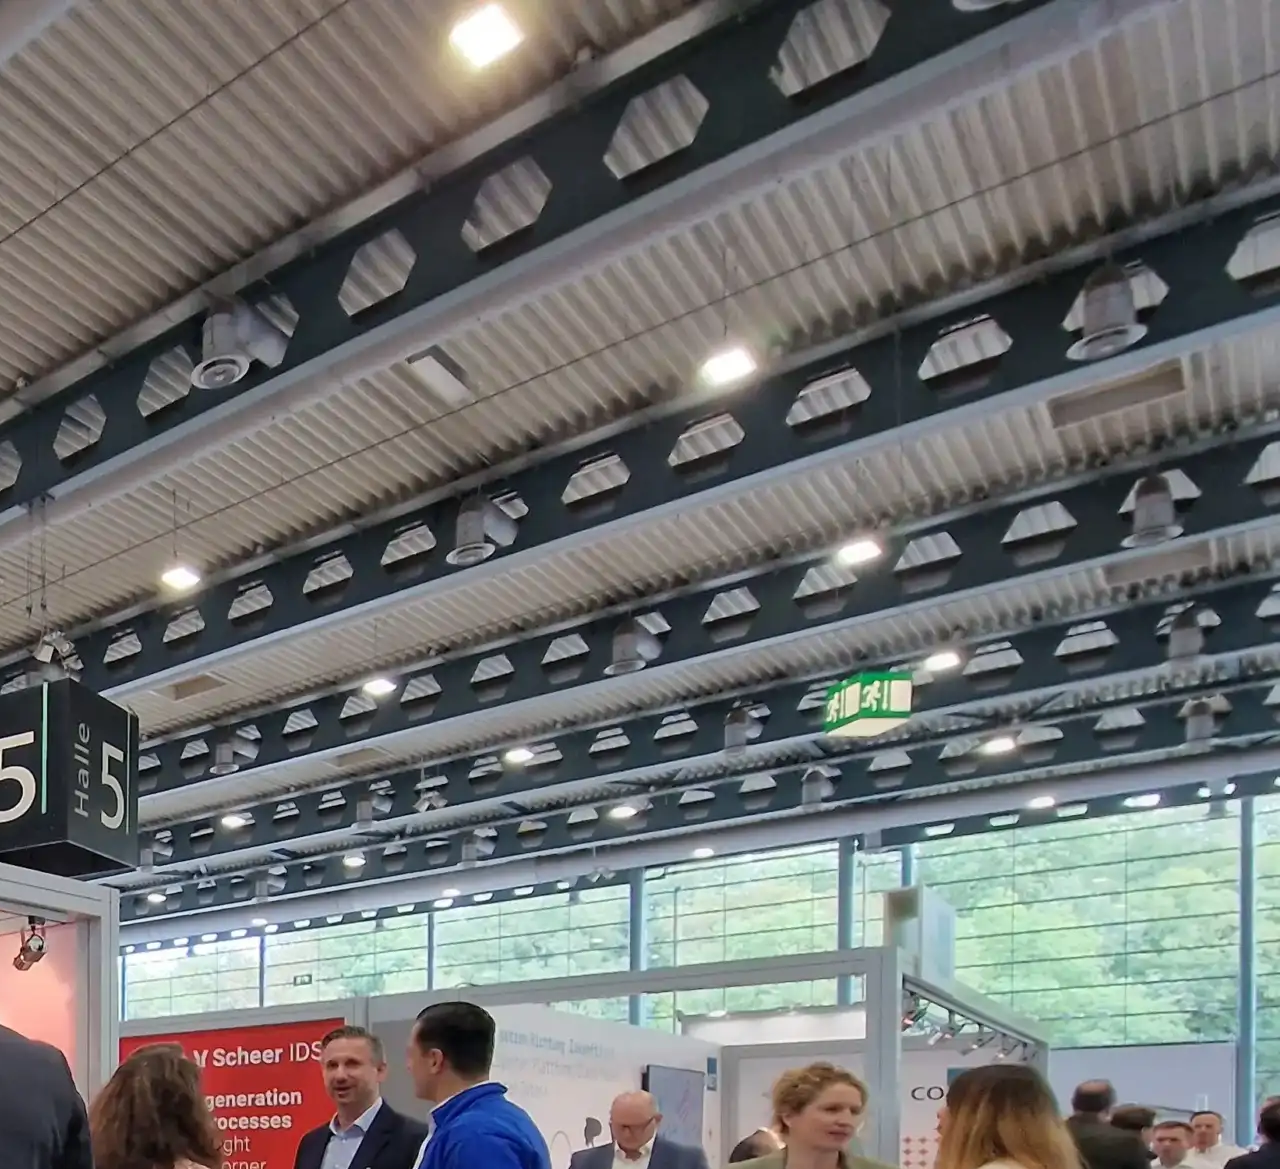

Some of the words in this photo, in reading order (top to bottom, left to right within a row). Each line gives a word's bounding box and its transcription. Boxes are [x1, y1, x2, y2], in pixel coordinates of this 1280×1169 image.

[73, 721, 90, 818] Halle
[100, 740, 125, 830] 5
[213, 1046, 283, 1067] Scheer
[290, 1041, 322, 1062] IDS
[205, 1088, 302, 1112] generation
[214, 1115, 293, 1130] ocesses
